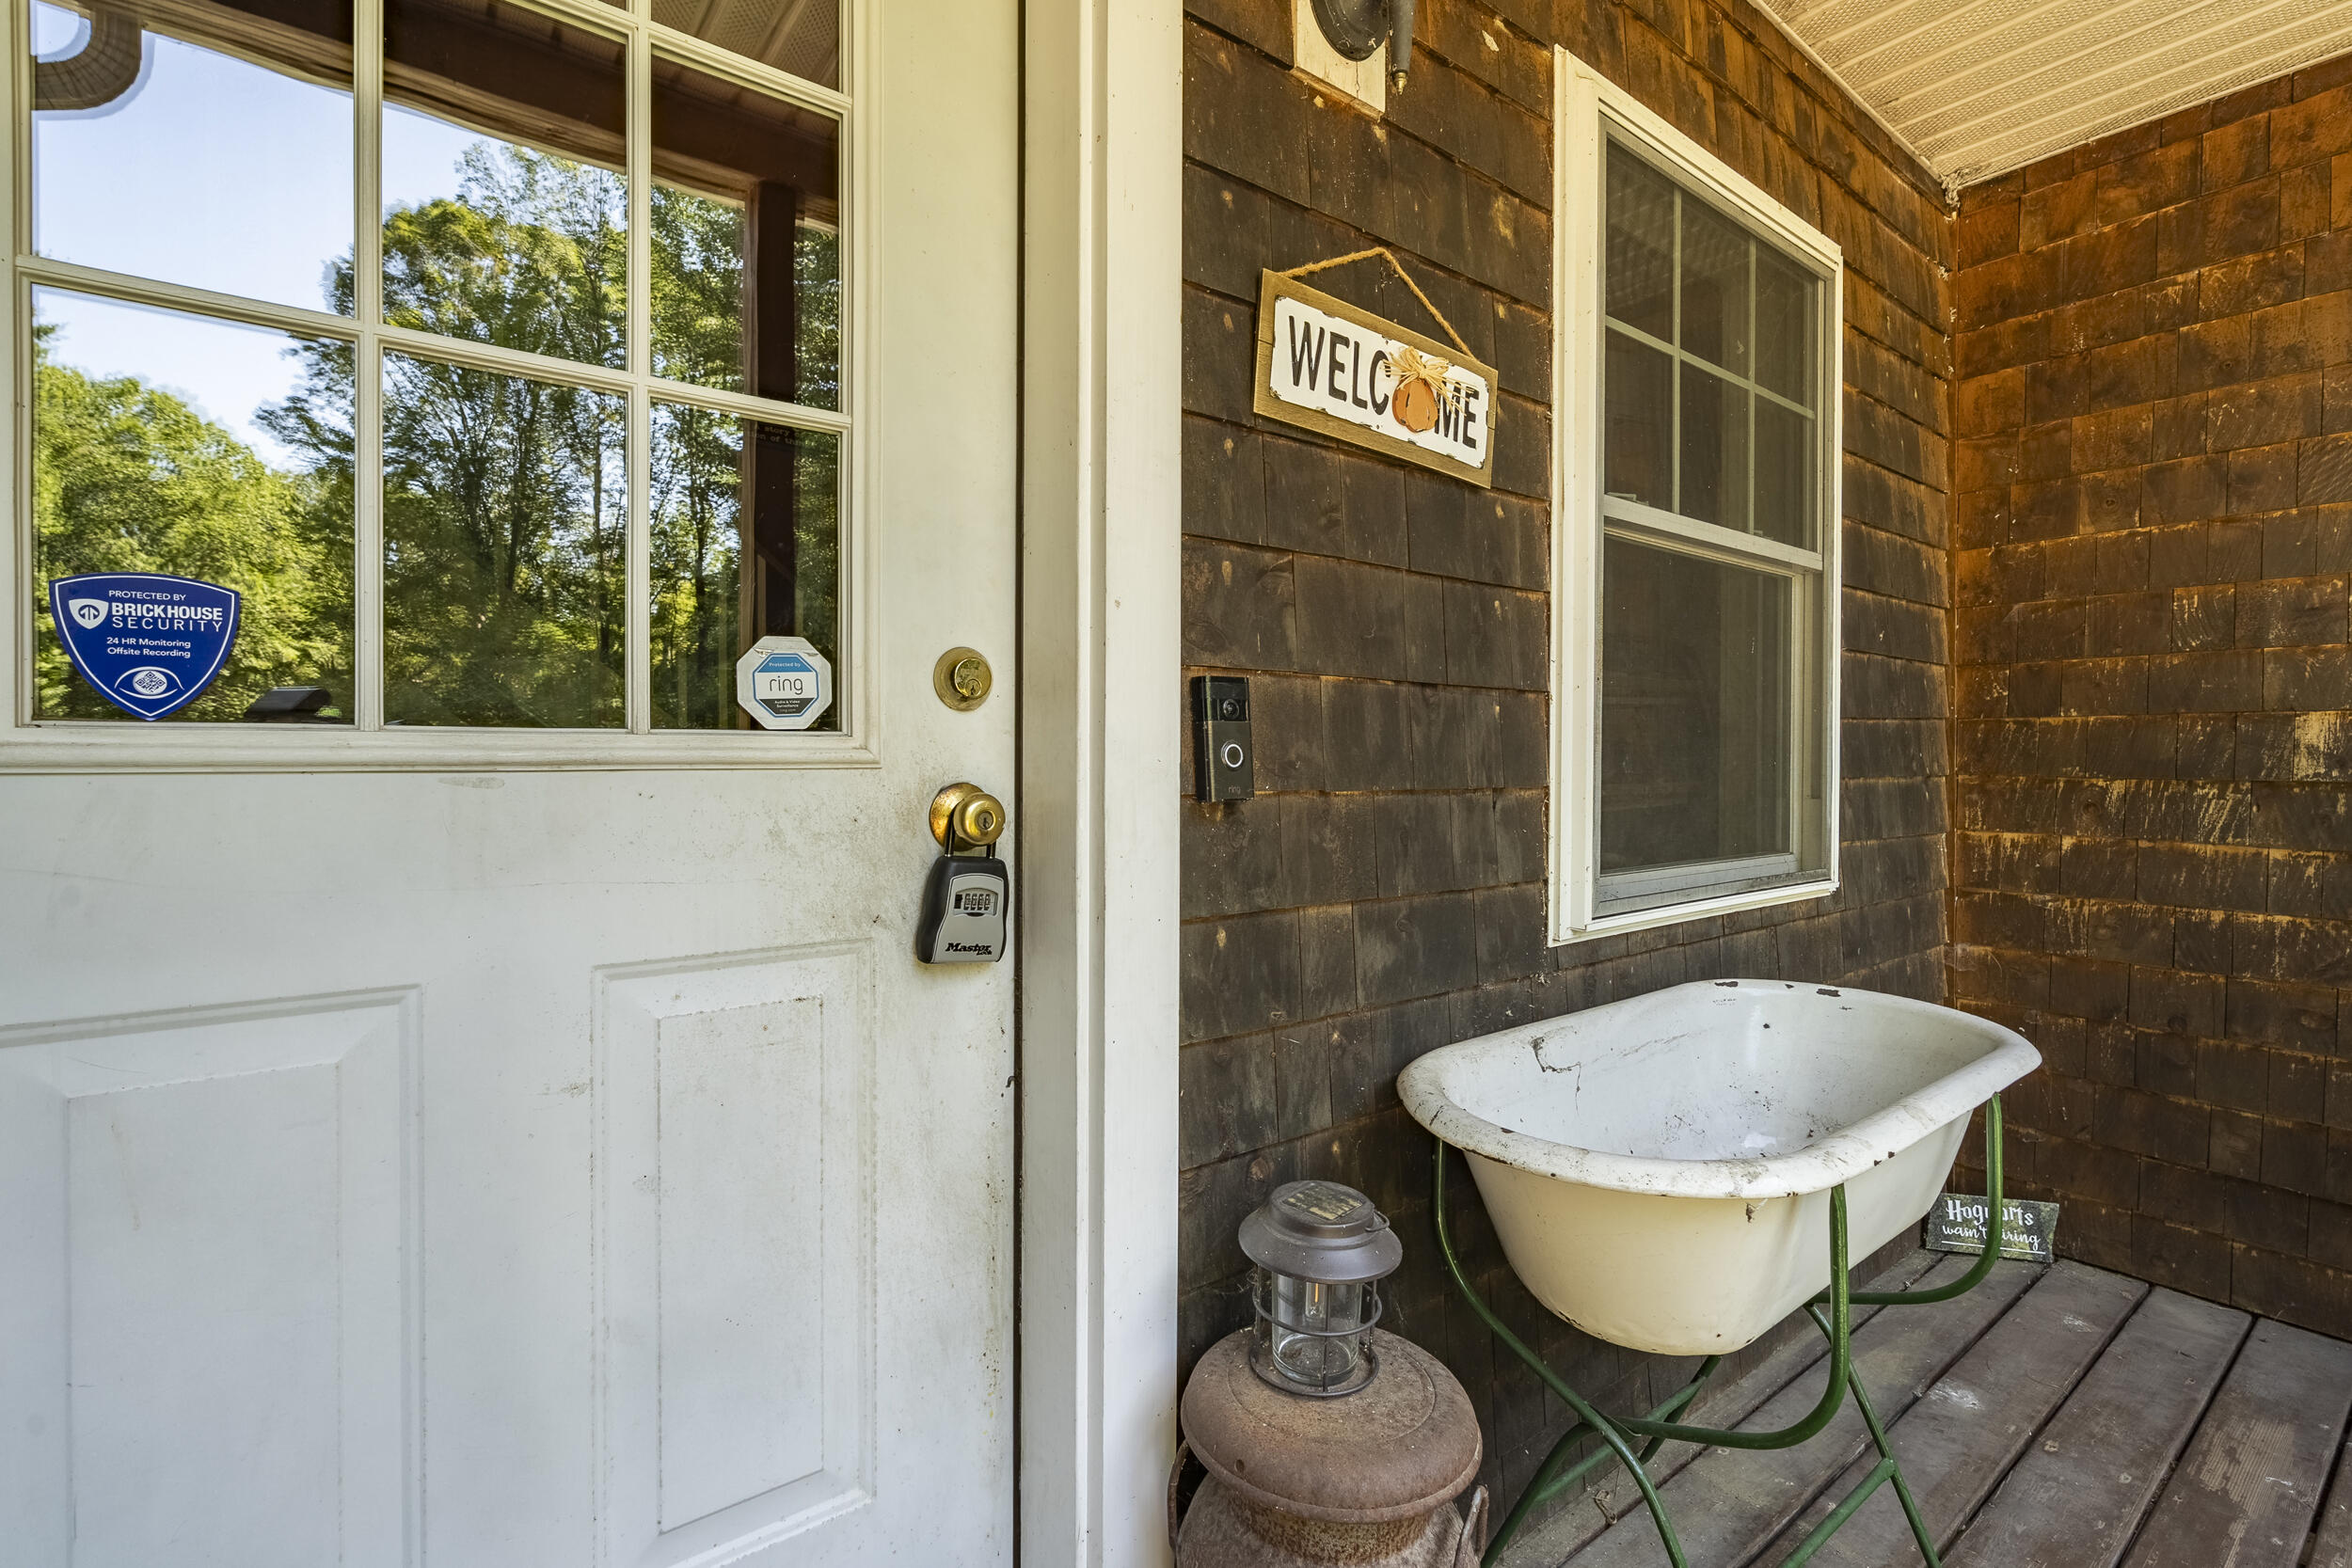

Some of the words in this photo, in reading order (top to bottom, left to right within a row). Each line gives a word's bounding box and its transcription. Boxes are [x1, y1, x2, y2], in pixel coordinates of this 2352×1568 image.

[1288, 315, 1480, 450] WELCME
[108, 590, 170, 601] PROTECTED
[111, 602, 223, 621] BRICKHOUSE
[112, 616, 223, 632] SECURITY
[121, 637, 136, 645] HR
[138, 638, 191, 649] Monitoring
[107, 647, 141, 656] Offsite
[143, 648, 191, 658] Recording
[770, 675, 803, 695] ring
[945, 942, 992, 953] Master
[1946, 1199, 2034, 1227] Hogrts
[2001, 1228, 2042, 1251] iring
